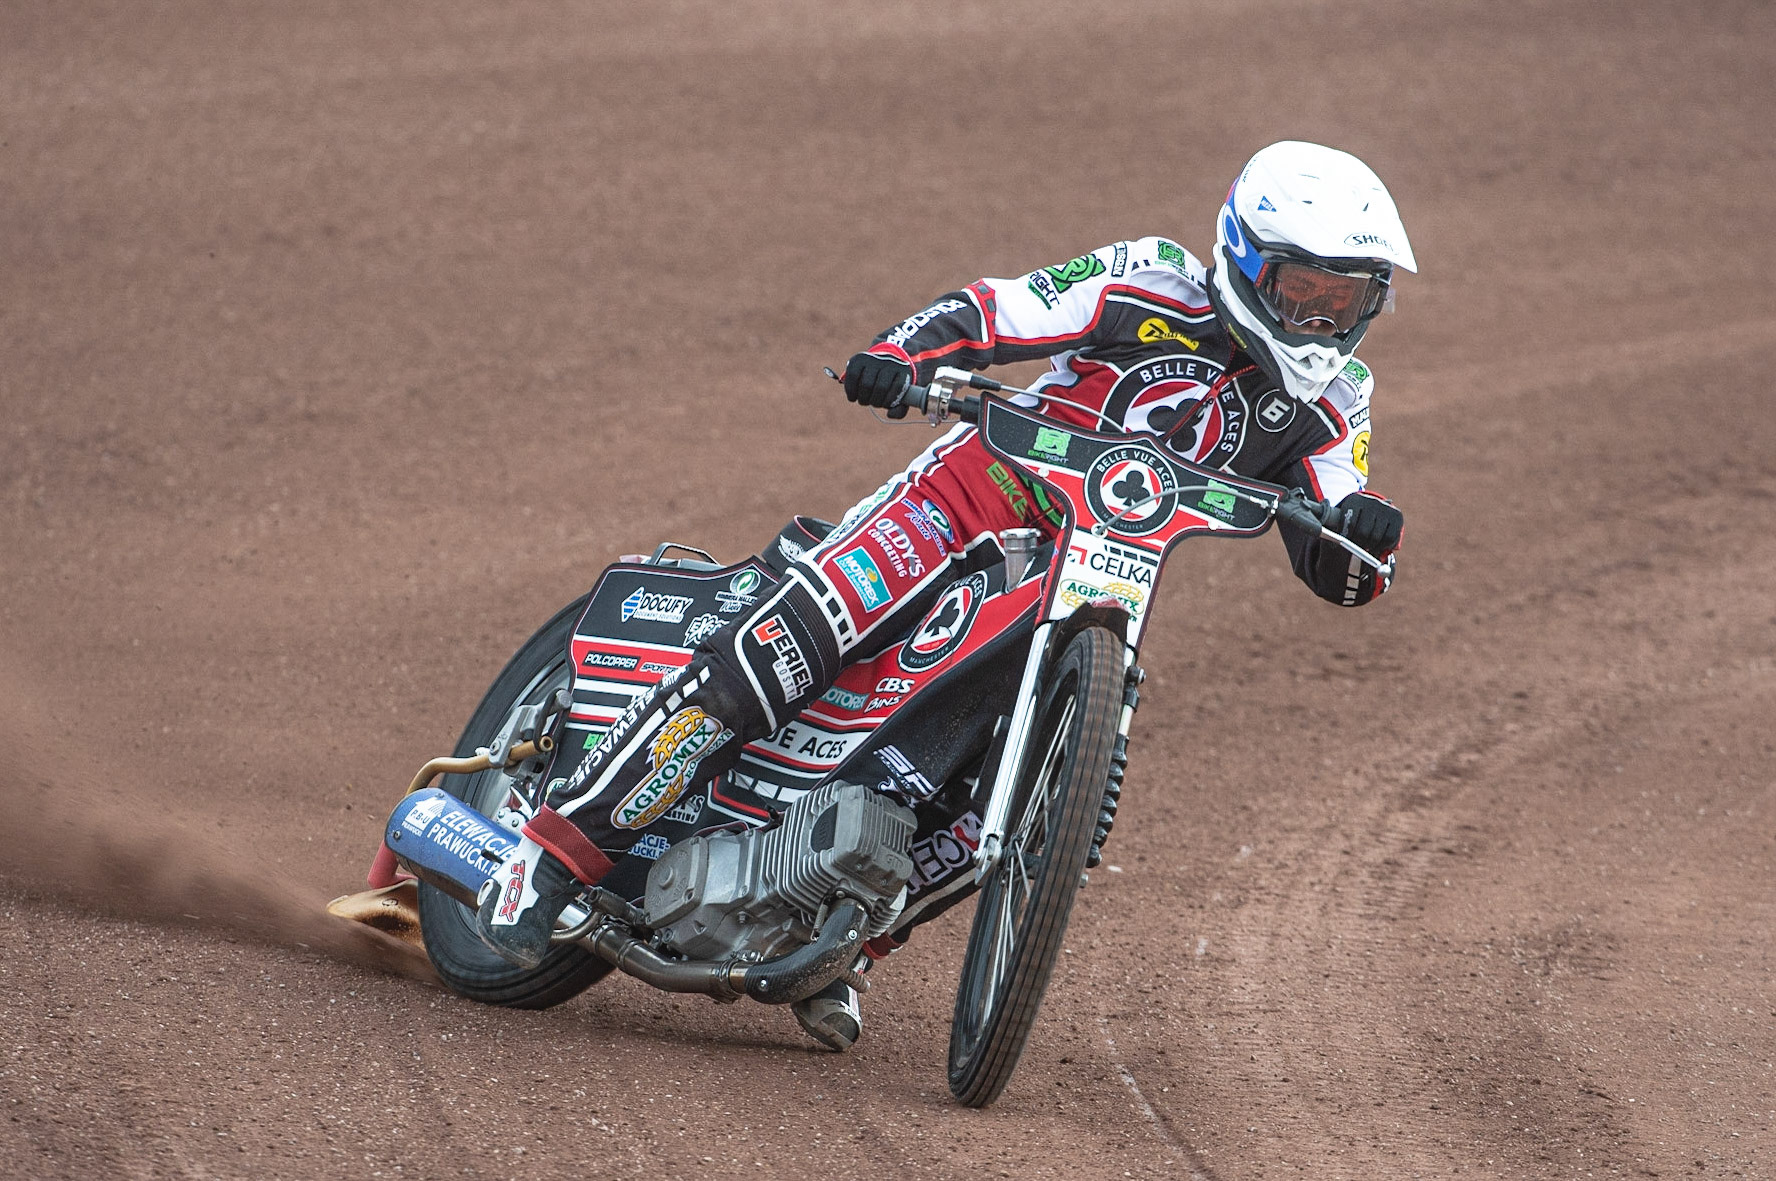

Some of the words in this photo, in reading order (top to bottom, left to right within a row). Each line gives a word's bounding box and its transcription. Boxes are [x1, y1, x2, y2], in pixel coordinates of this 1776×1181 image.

[1140, 362, 1197, 383] BELLE
[1221, 410, 1242, 453] ACES
[1096, 450, 1128, 473] BELLE
[1133, 451, 1157, 466] VUE
[868, 528, 908, 578] CONCRETING
[875, 518, 925, 578] OLDY'S
[844, 555, 879, 605] MOTOREX
[1090, 553, 1152, 588] CELKA
[640, 596, 692, 614] DOCUFY
[585, 653, 638, 669] POLCOPPER
[875, 677, 915, 693] CBS
[864, 696, 902, 713] BINS
[798, 737, 847, 759] ACES
[623, 724, 715, 823] AGROMIX
[499, 860, 526, 922] TCX
